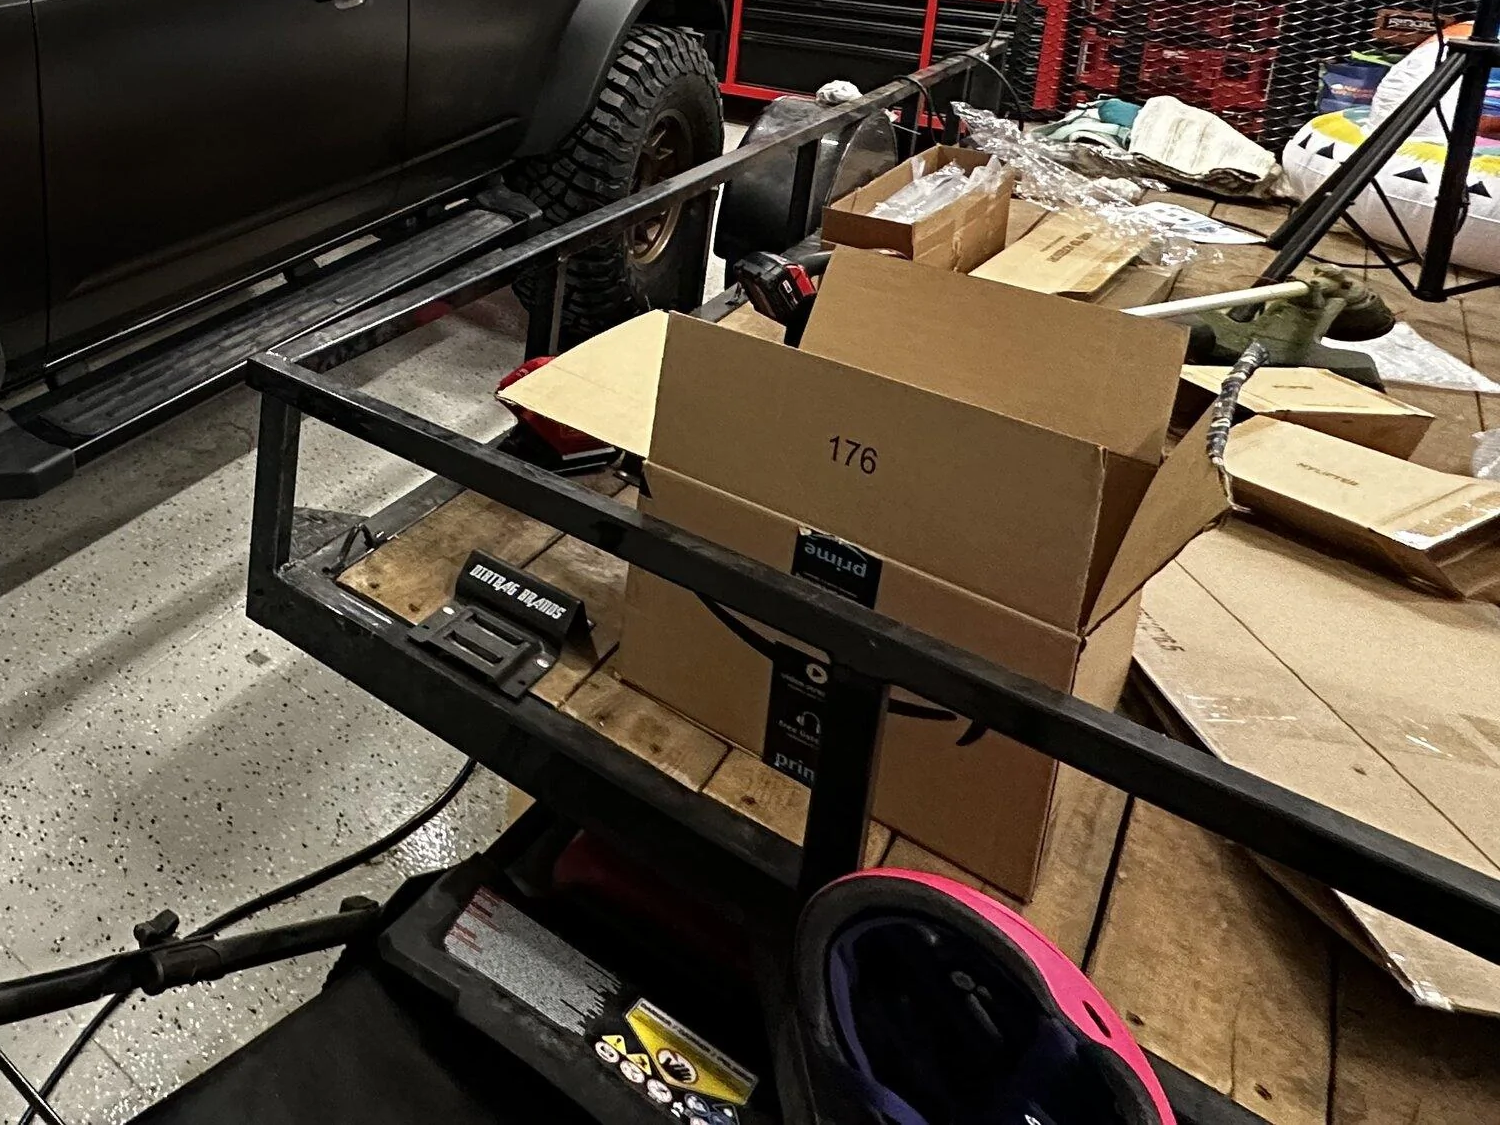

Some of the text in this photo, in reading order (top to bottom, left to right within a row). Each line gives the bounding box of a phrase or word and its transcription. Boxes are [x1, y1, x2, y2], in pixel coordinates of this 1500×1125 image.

[829, 435, 878, 475] 176
[804, 541, 867, 578] prime
[469, 563, 568, 620] DIRTBAG BRANDS
